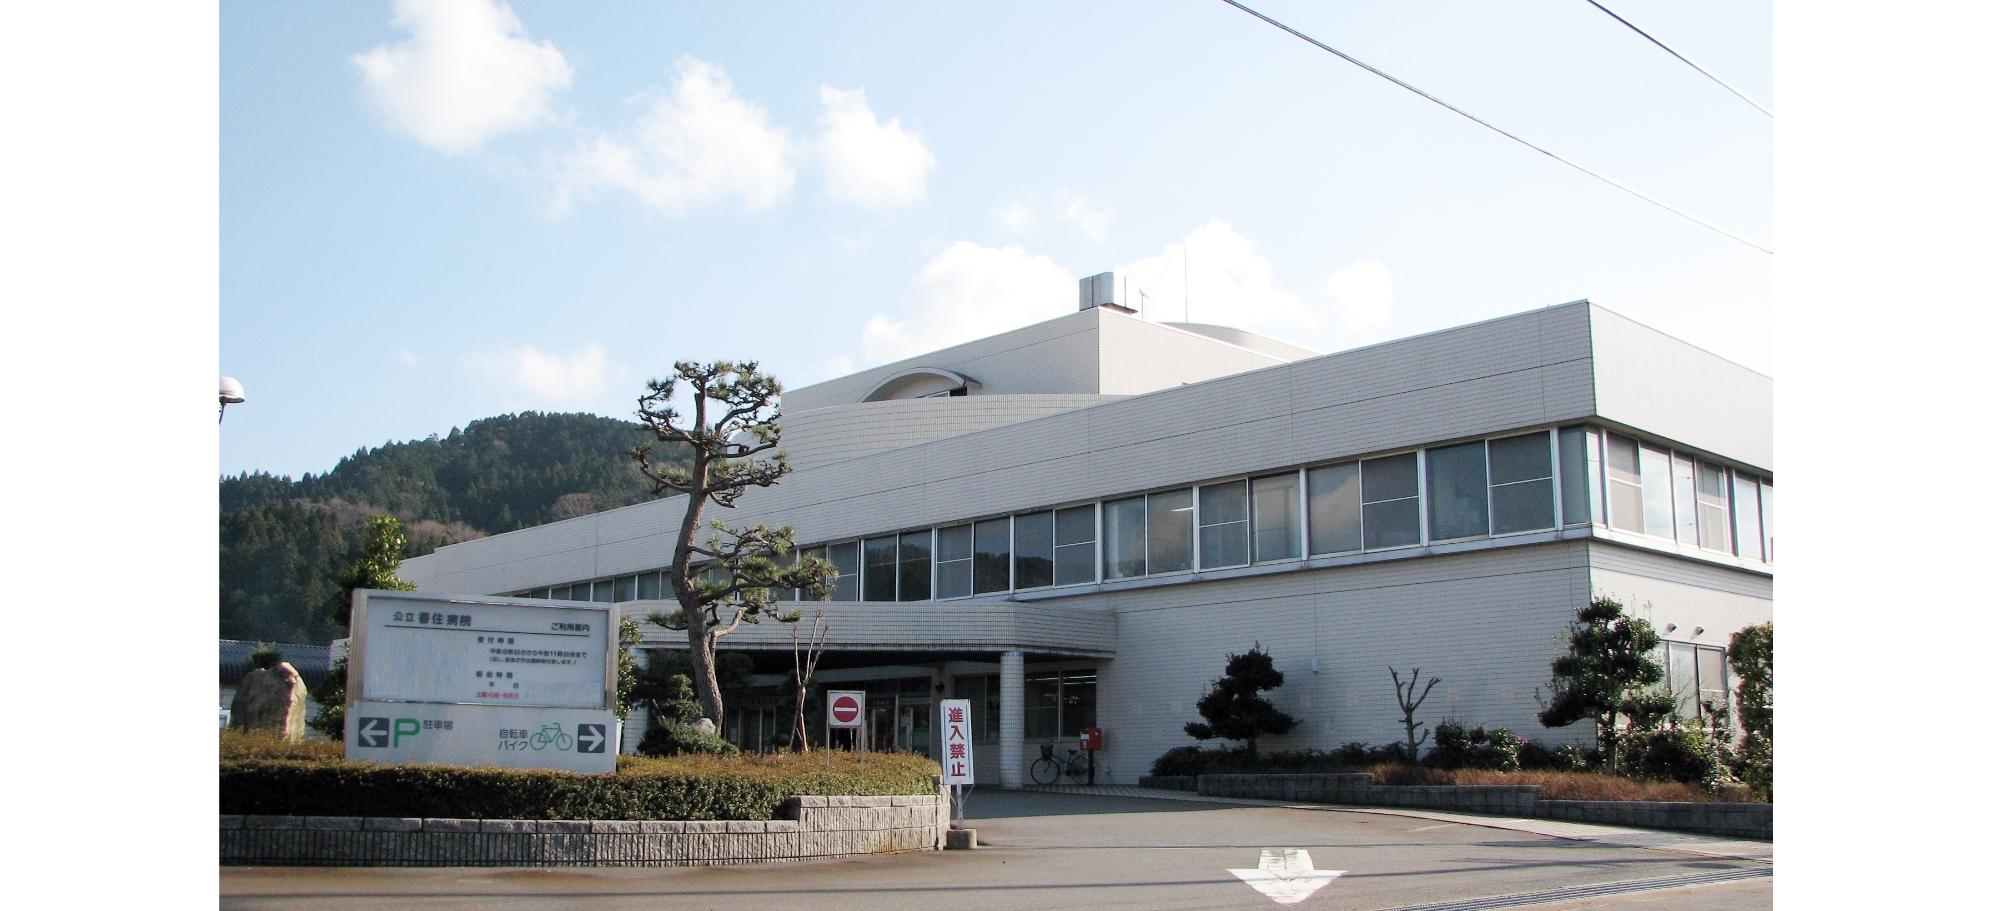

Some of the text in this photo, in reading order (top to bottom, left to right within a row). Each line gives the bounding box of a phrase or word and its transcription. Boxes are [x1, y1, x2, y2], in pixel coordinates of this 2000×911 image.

[423, 719, 453, 731] 駐車場
[393, 718, 420, 748] P
[499, 728, 528, 739] 自転車
[499, 740, 528, 751] バイク
[948, 707, 967, 777] 進入禁止
